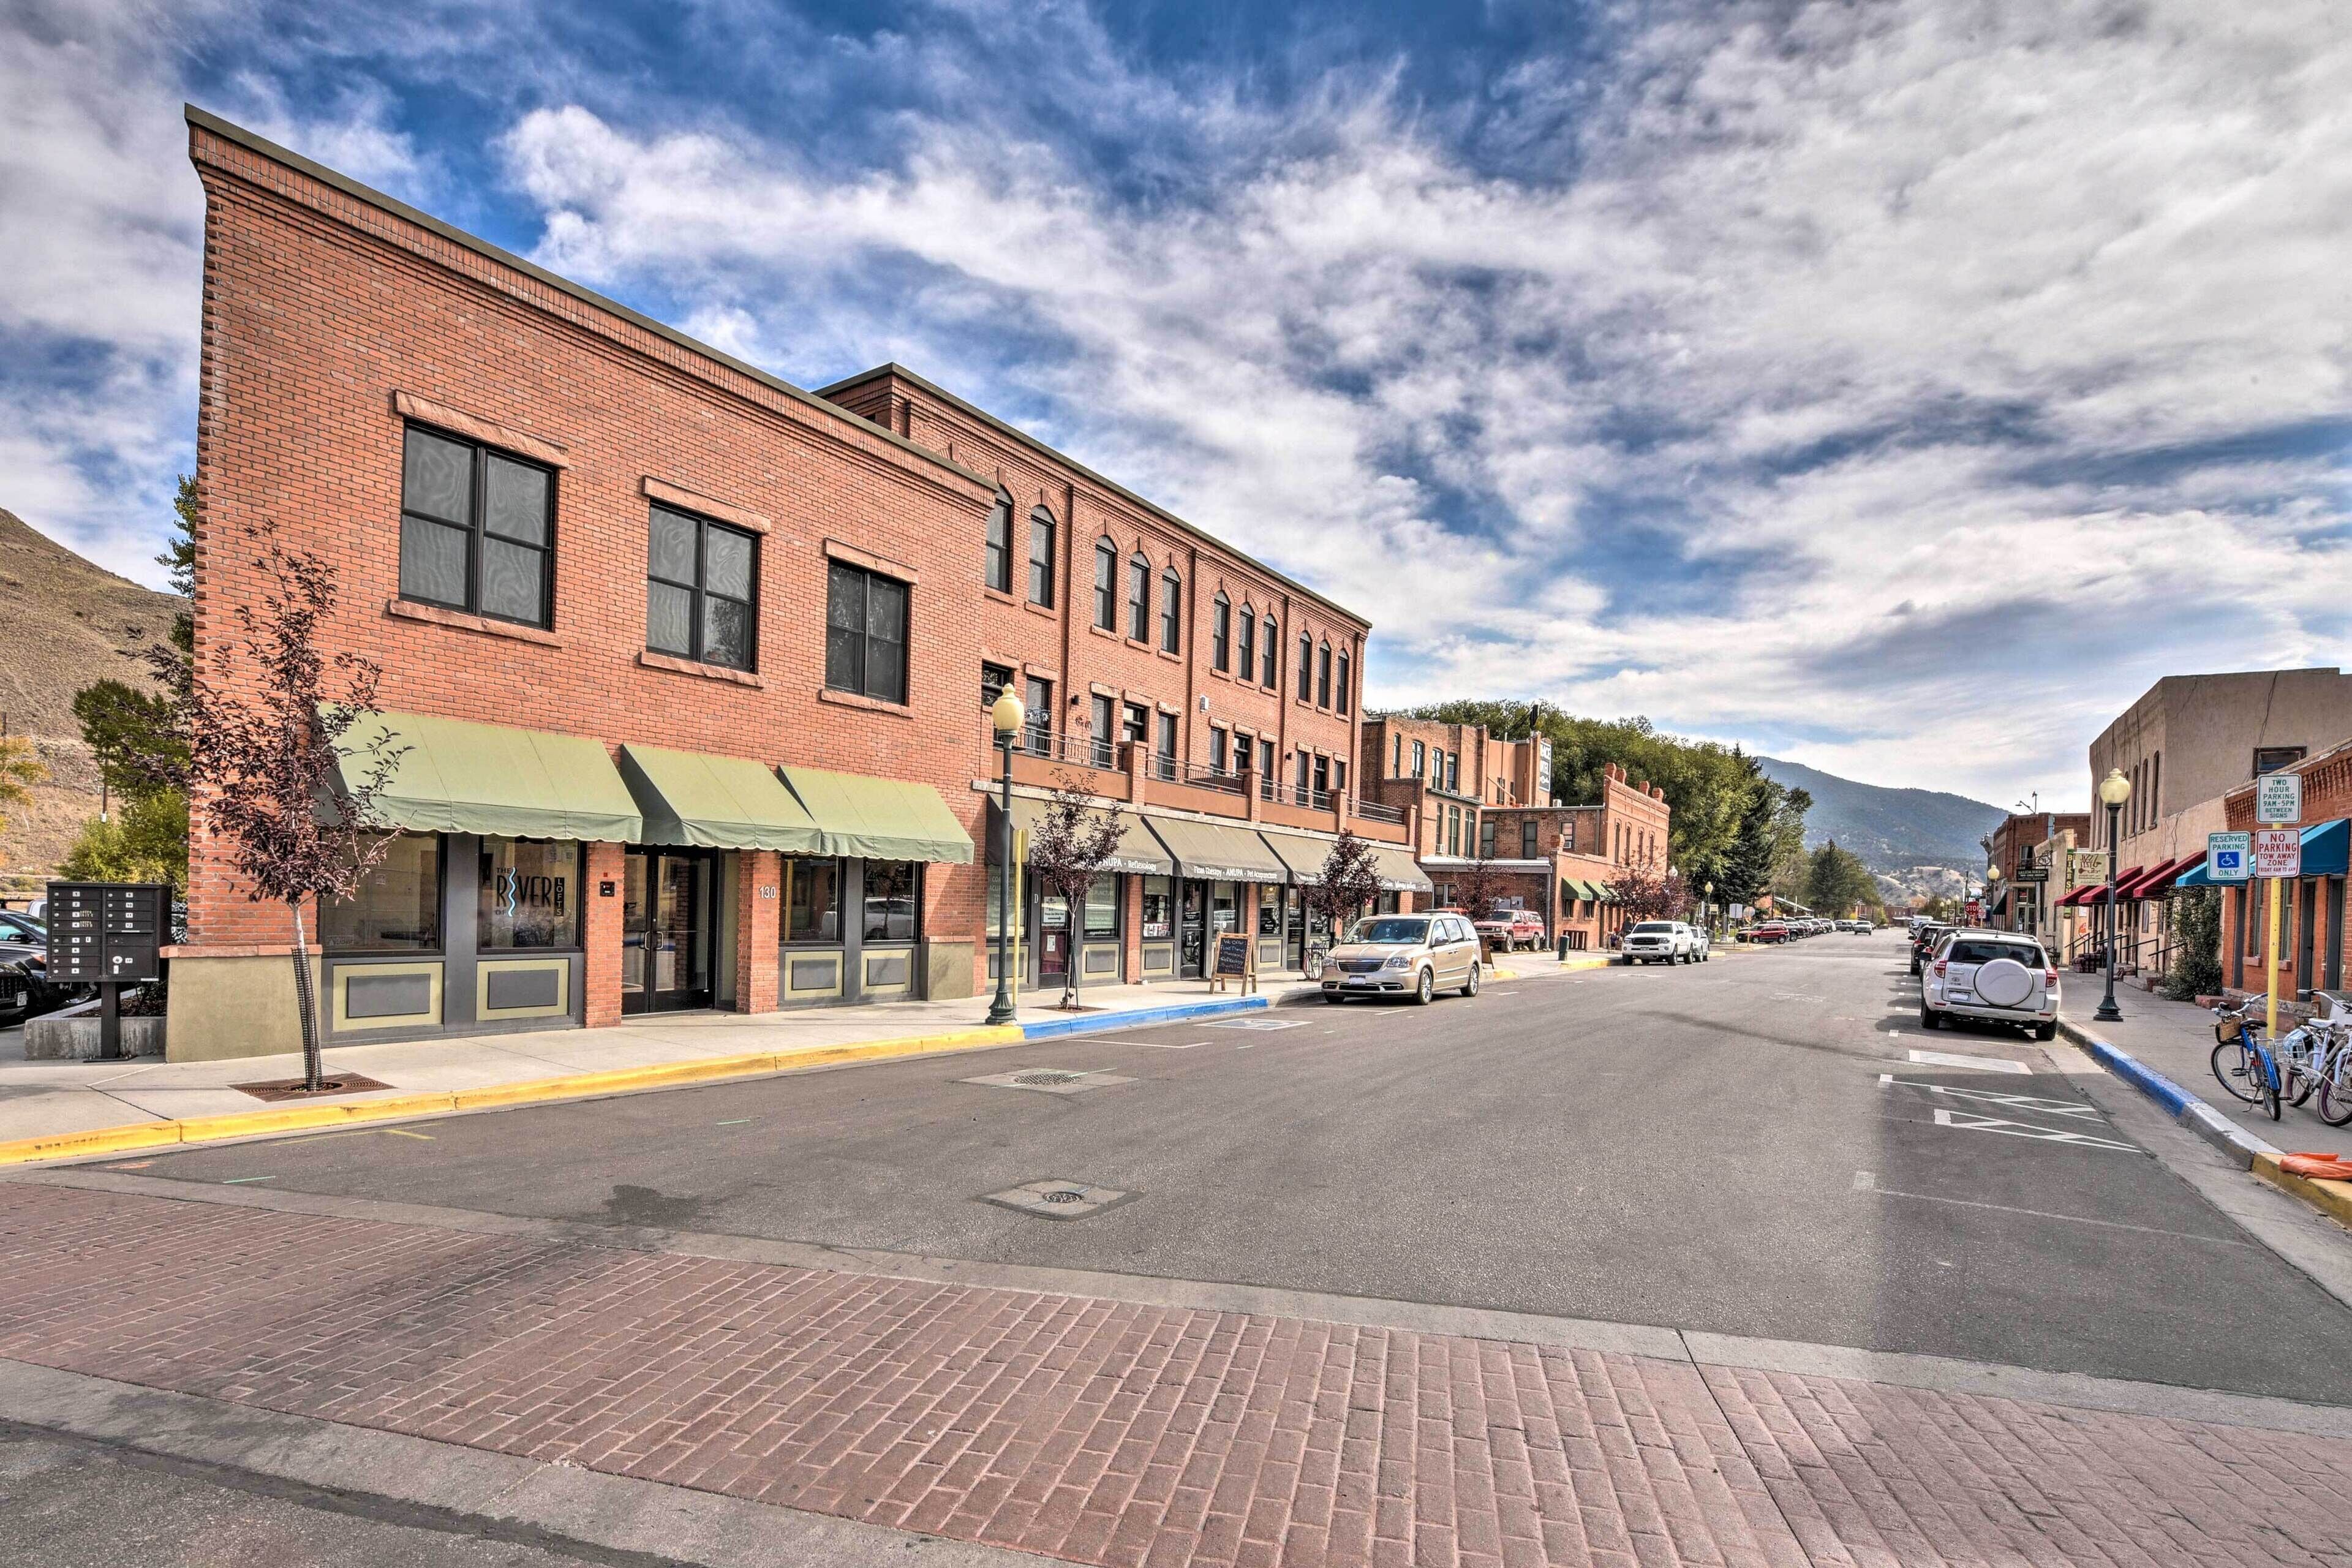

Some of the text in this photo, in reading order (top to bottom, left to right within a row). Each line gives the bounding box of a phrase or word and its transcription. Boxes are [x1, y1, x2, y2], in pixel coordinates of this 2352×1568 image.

[2271, 834, 2285, 842] NO
[2259, 843, 2296, 852] PARKING
[1099, 858, 1156, 872] NUPA Reflexology
[1194, 865, 1205, 874] Float
[1205, 867, 1223, 877] Therapy
[1226, 869, 1243, 877] ANUPA
[760, 886, 776, 899] 130
[1034, 894, 1039, 903] D
